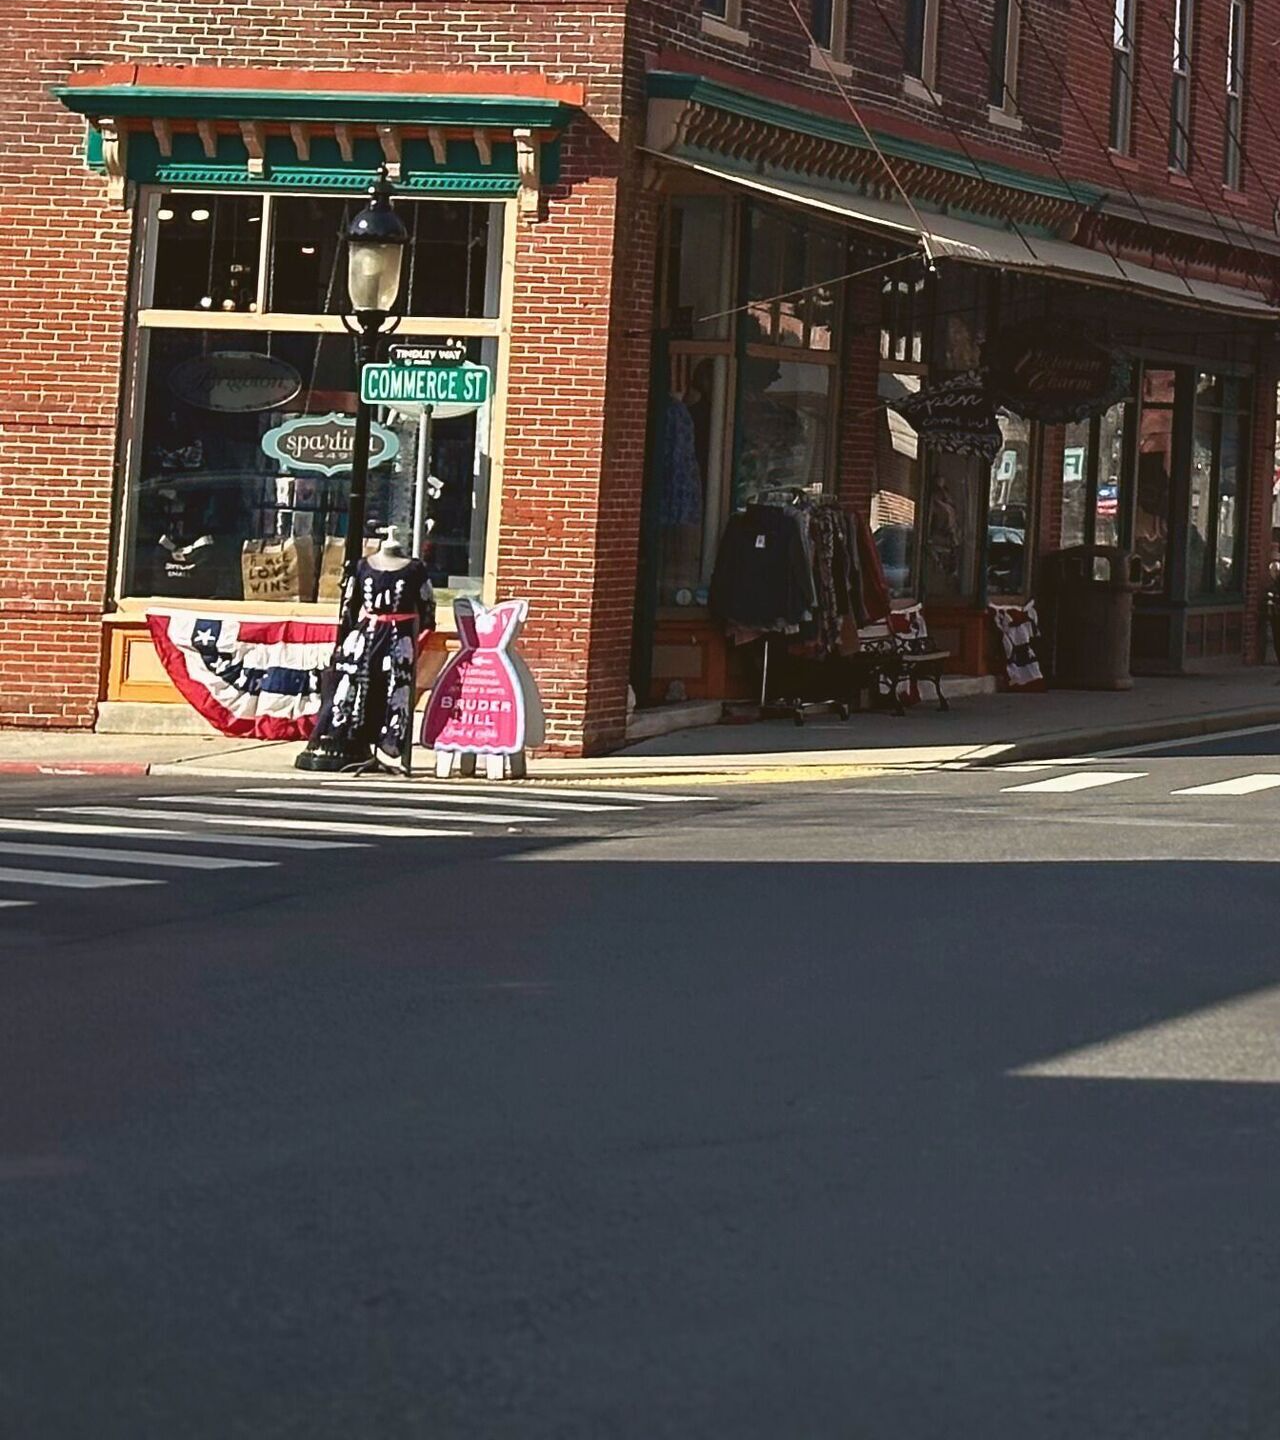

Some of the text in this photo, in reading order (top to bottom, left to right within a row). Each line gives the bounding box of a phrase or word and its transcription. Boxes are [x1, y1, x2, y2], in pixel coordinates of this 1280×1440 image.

[438, 350, 462, 360] WAY
[368, 369, 484, 400] COMMERCE ST
[441, 696, 512, 713] BRUDER
[454, 711, 496, 726] HILL
